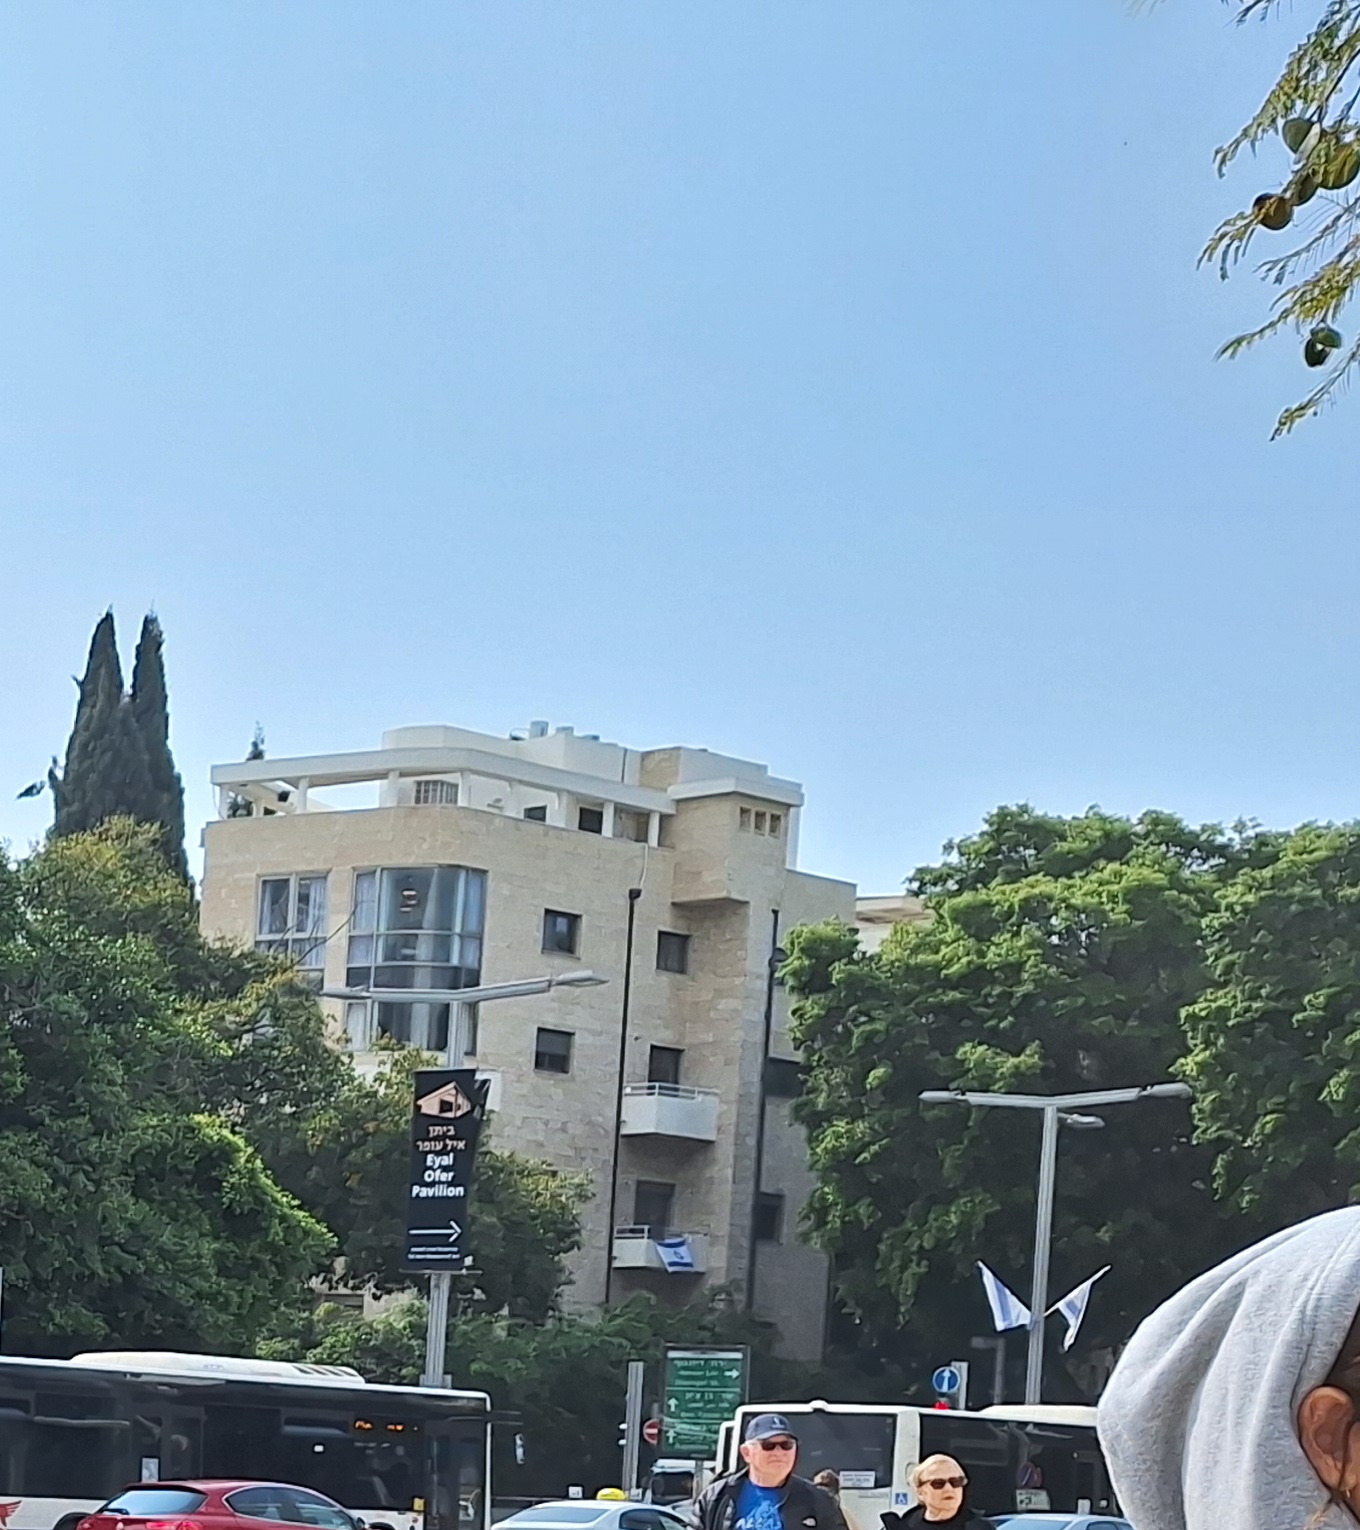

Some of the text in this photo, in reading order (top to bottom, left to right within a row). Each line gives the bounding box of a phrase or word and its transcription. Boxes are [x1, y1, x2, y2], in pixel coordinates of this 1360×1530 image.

[428, 1126, 454, 1137] ביתן
[426, 1153, 454, 1169] Eyal
[423, 1169, 454, 1182] Ofer
[412, 1184, 464, 1198] Pavilion
